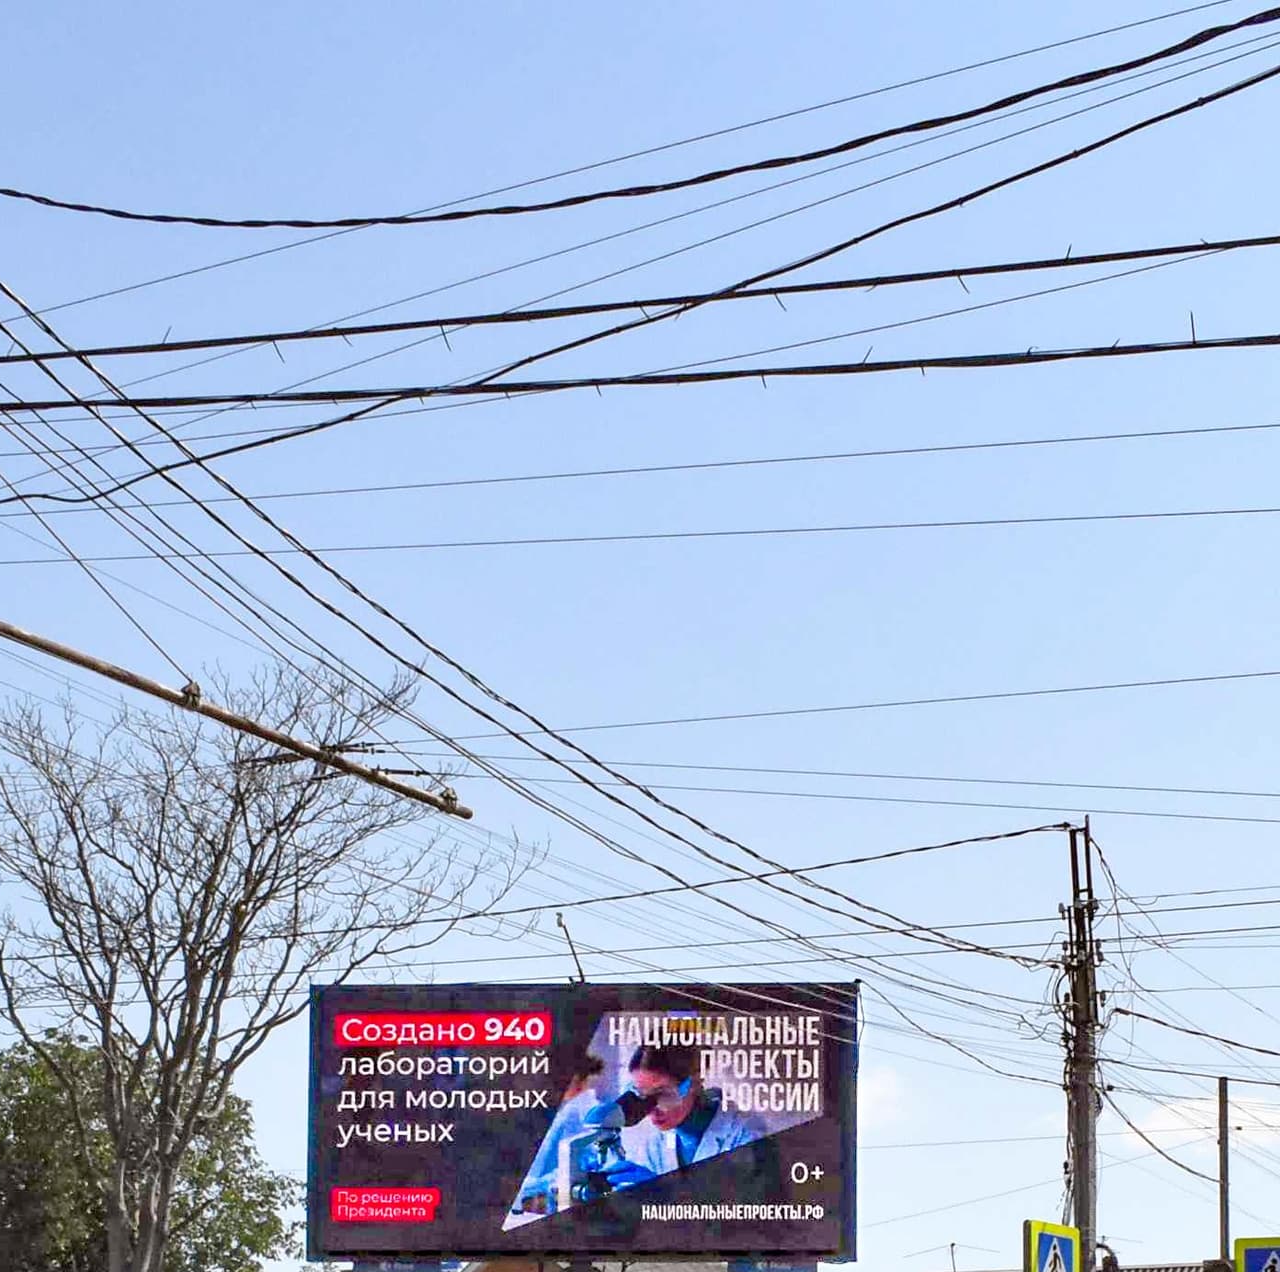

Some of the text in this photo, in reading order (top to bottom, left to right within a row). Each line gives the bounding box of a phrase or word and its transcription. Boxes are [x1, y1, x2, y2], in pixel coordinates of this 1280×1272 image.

[341, 1017, 545, 1044] Создано 940
[608, 1016, 821, 1049] НАЦИОНАЛЬНЫЕ
[338, 1051, 549, 1079] лабораторий
[699, 1049, 819, 1079] ПРОЕКТЫ
[337, 1090, 548, 1112] для молодых
[721, 1082, 819, 1112] РОССИИ
[336, 1123, 454, 1148] ученых
[790, 1162, 824, 1184] 0+
[338, 1191, 433, 1205] По решению
[338, 1205, 427, 1221] Президента
[642, 1204, 824, 1221] НАЦИОНАЛЬНЫЕПРОЕКТЫ.РФ
